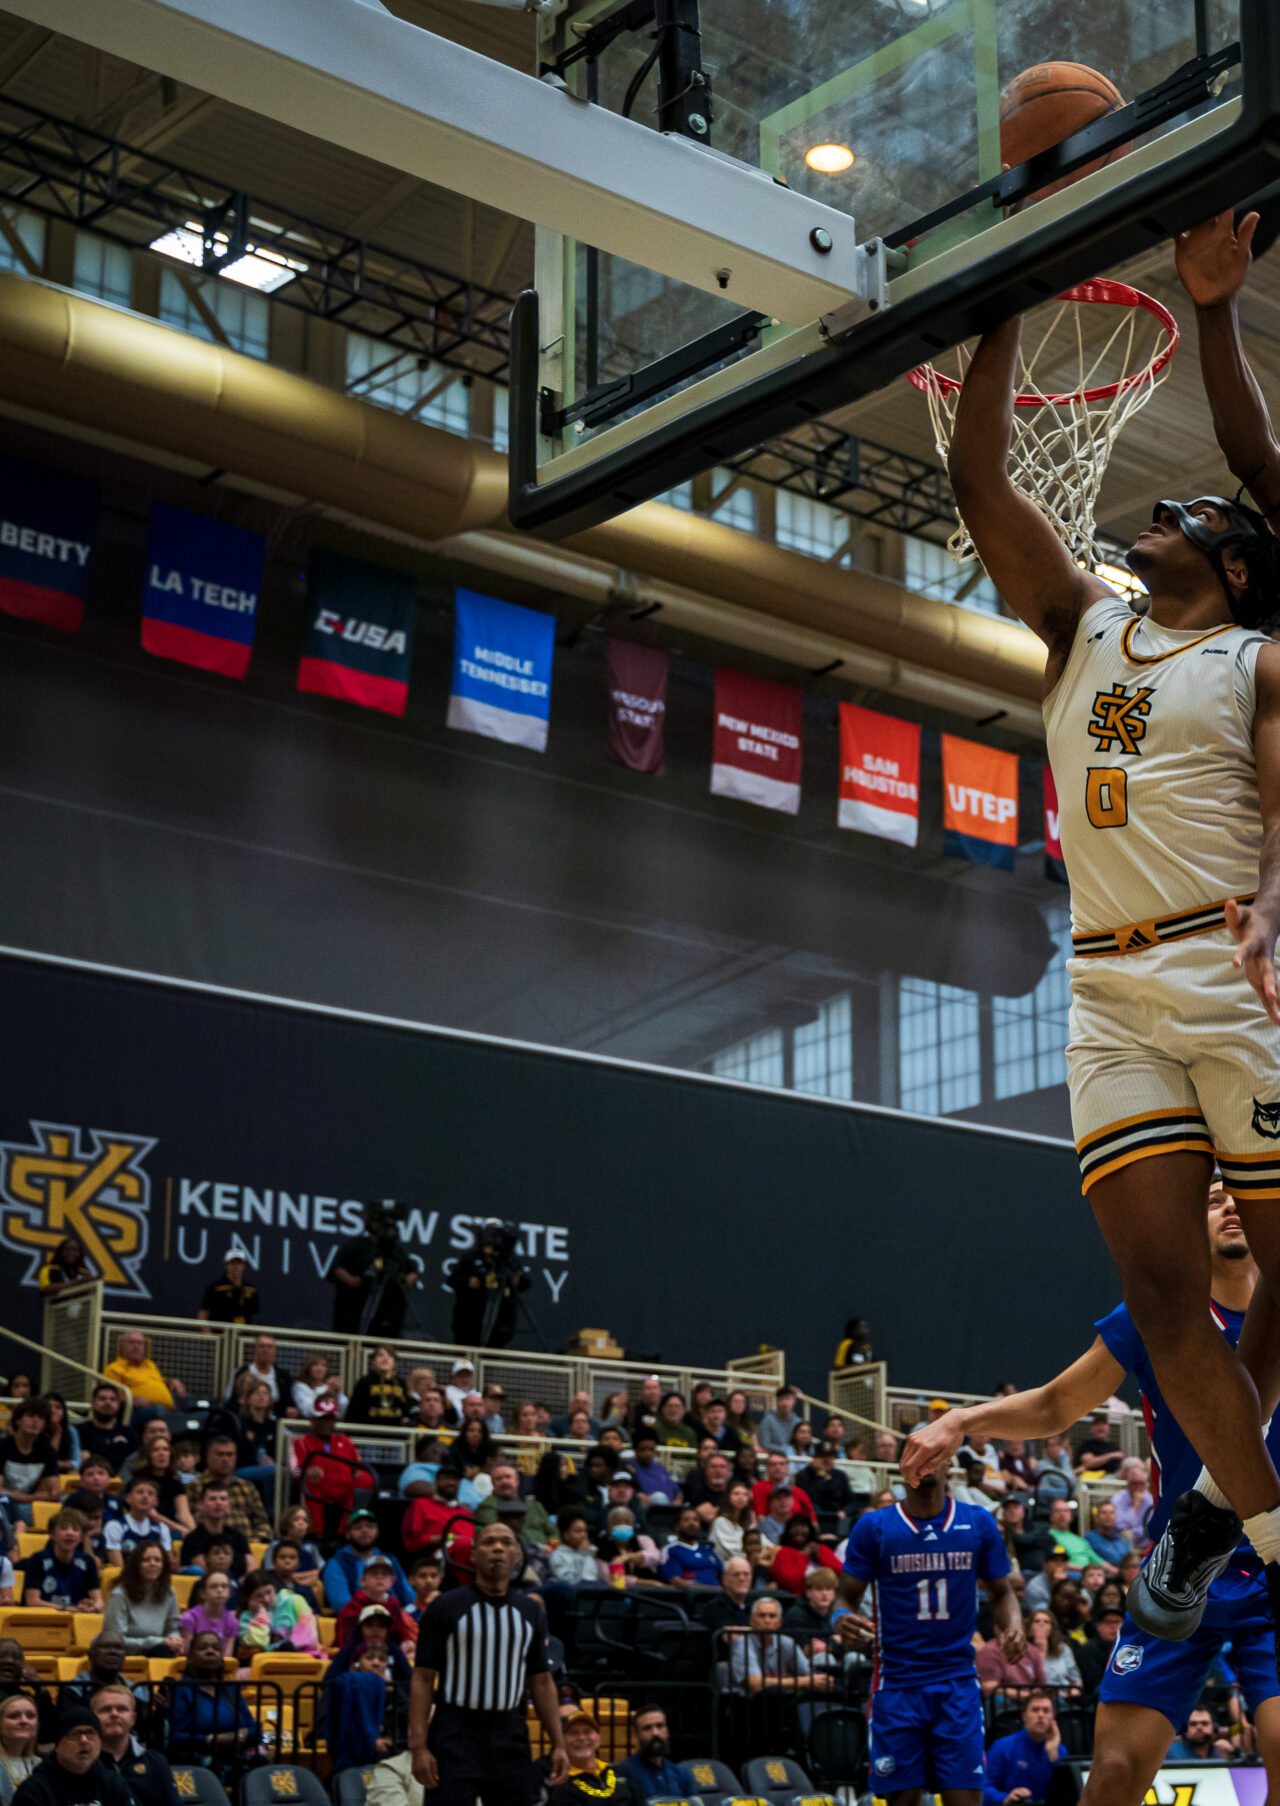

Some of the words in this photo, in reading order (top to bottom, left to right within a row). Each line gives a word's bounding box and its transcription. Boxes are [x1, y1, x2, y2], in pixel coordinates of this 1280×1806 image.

[151, 565, 183, 595] LA
[191, 577, 257, 614] TECH
[474, 646, 534, 675] MIDDLE
[844, 765, 918, 801] HOUSTON
[862, 753, 899, 778] SAM
[949, 783, 1017, 823] UTEP
[1085, 766, 1129, 829] 0
[179, 1177, 440, 1245] KENNESW
[891, 1553, 946, 1573] LOUISIANA
[947, 1551, 972, 1570] TECH
[916, 1578, 950, 1621] 11
